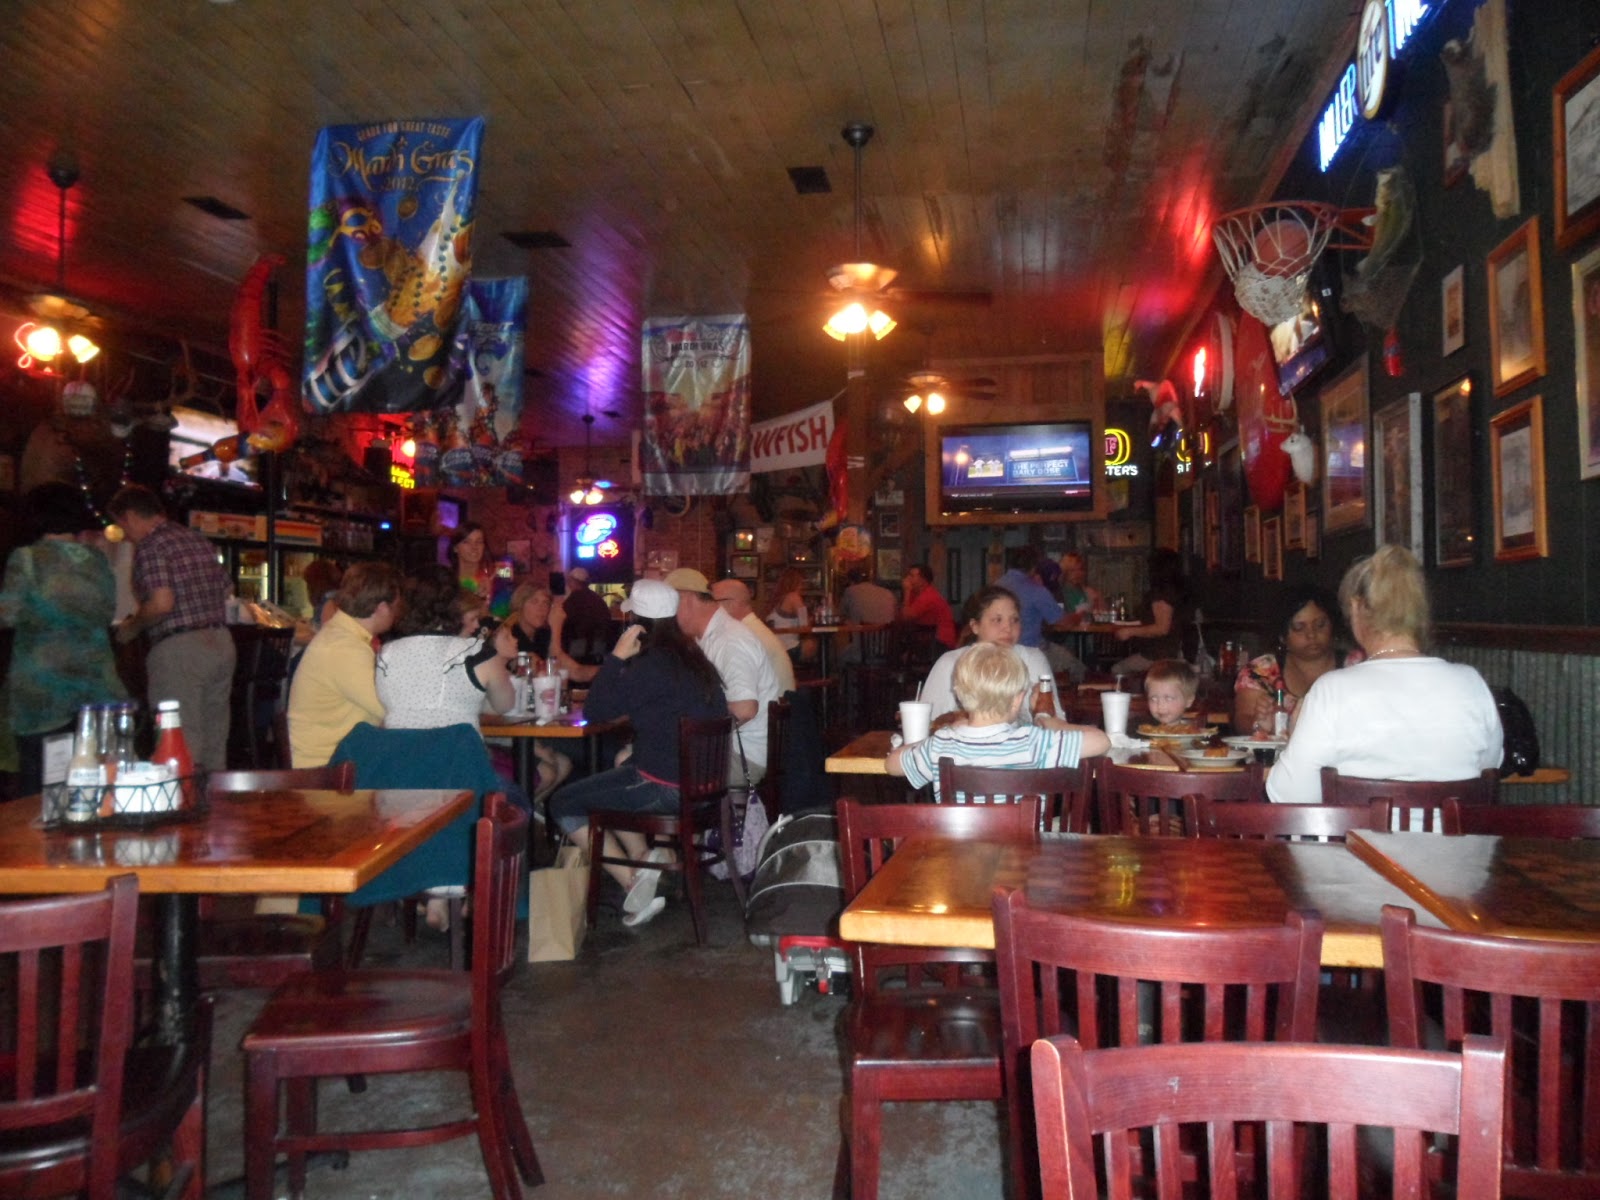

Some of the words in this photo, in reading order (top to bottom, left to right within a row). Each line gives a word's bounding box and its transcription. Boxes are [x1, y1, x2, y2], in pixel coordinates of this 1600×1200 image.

[400, 120, 425, 133] GREAT
[427, 122, 452, 139] TASTE
[331, 138, 405, 191] Mardi
[410, 141, 475, 181] Gras
[670, 342, 700, 353] MARDI
[701, 342, 725, 352] GRAS
[751, 415, 829, 458] WFISH
